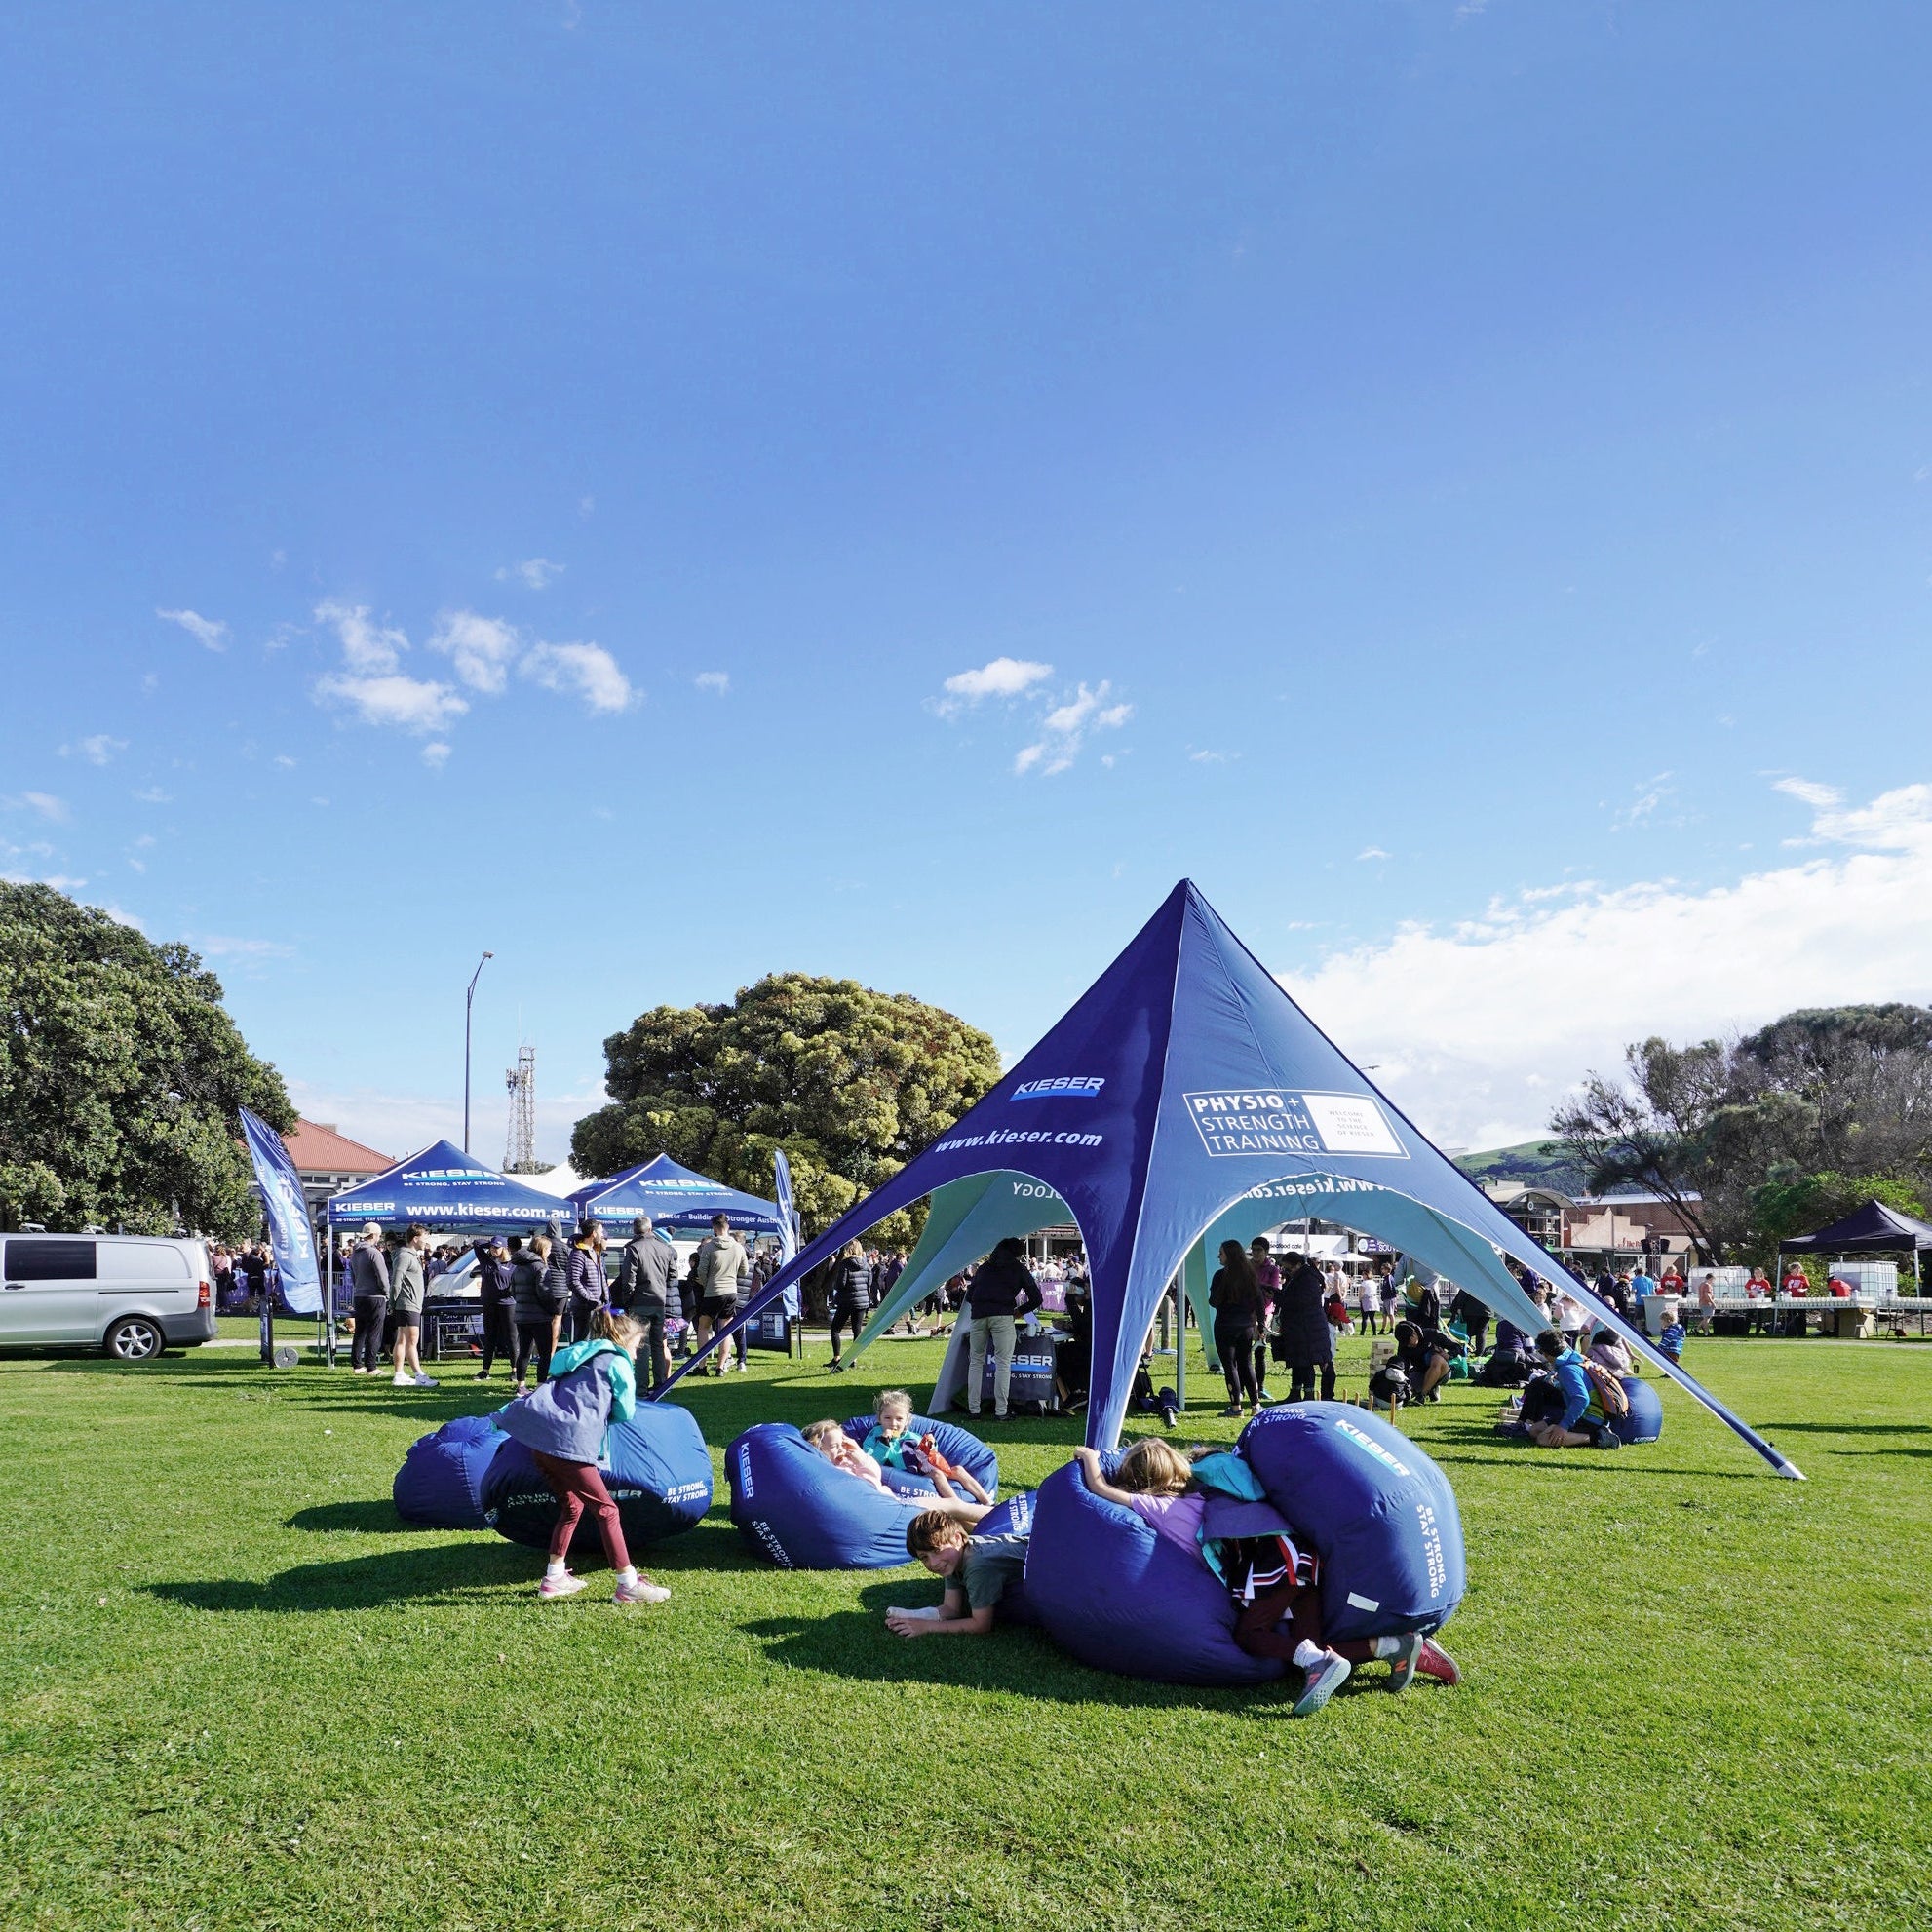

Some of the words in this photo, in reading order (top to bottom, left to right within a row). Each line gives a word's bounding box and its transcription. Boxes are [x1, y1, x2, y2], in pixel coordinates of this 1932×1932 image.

[1014, 1077, 1105, 1095] KIESER
[1193, 1095, 1284, 1113] PHYSIO
[1201, 1114, 1311, 1131] STRENGTH
[935, 1128, 1103, 1153] www.kieser.com
[1209, 1134, 1319, 1150] TRAINING
[402, 1169, 501, 1179] KIESER
[639, 1180, 727, 1190] KIESER
[336, 1202, 395, 1212] KIESER
[406, 1203, 571, 1219] www.kieser.com.au
[593, 1206, 645, 1215] KIESER
[726, 1215, 755, 1223] Stronger
[987, 1354, 1052, 1366] KESER
[1264, 1414, 1307, 1424] STRONG
[1336, 1419, 1410, 1476] KIESER
[741, 1442, 754, 1499] KIESER
[661, 1495, 682, 1504] STAY
[683, 1488, 708, 1502] STRONG
[667, 1487, 677, 1496] BE
[678, 1480, 705, 1494] STRONG,
[913, 1488, 937, 1498] STRO
[1009, 1505, 1020, 1532] STRONG
[751, 1520, 768, 1540] STAY
[760, 1521, 770, 1533] BE
[1417, 1504, 1430, 1537] STAY
[1425, 1542, 1439, 1598] STRONG
[1425, 1507, 1435, 1524] BE
[1430, 1527, 1446, 1588] STRONG,
